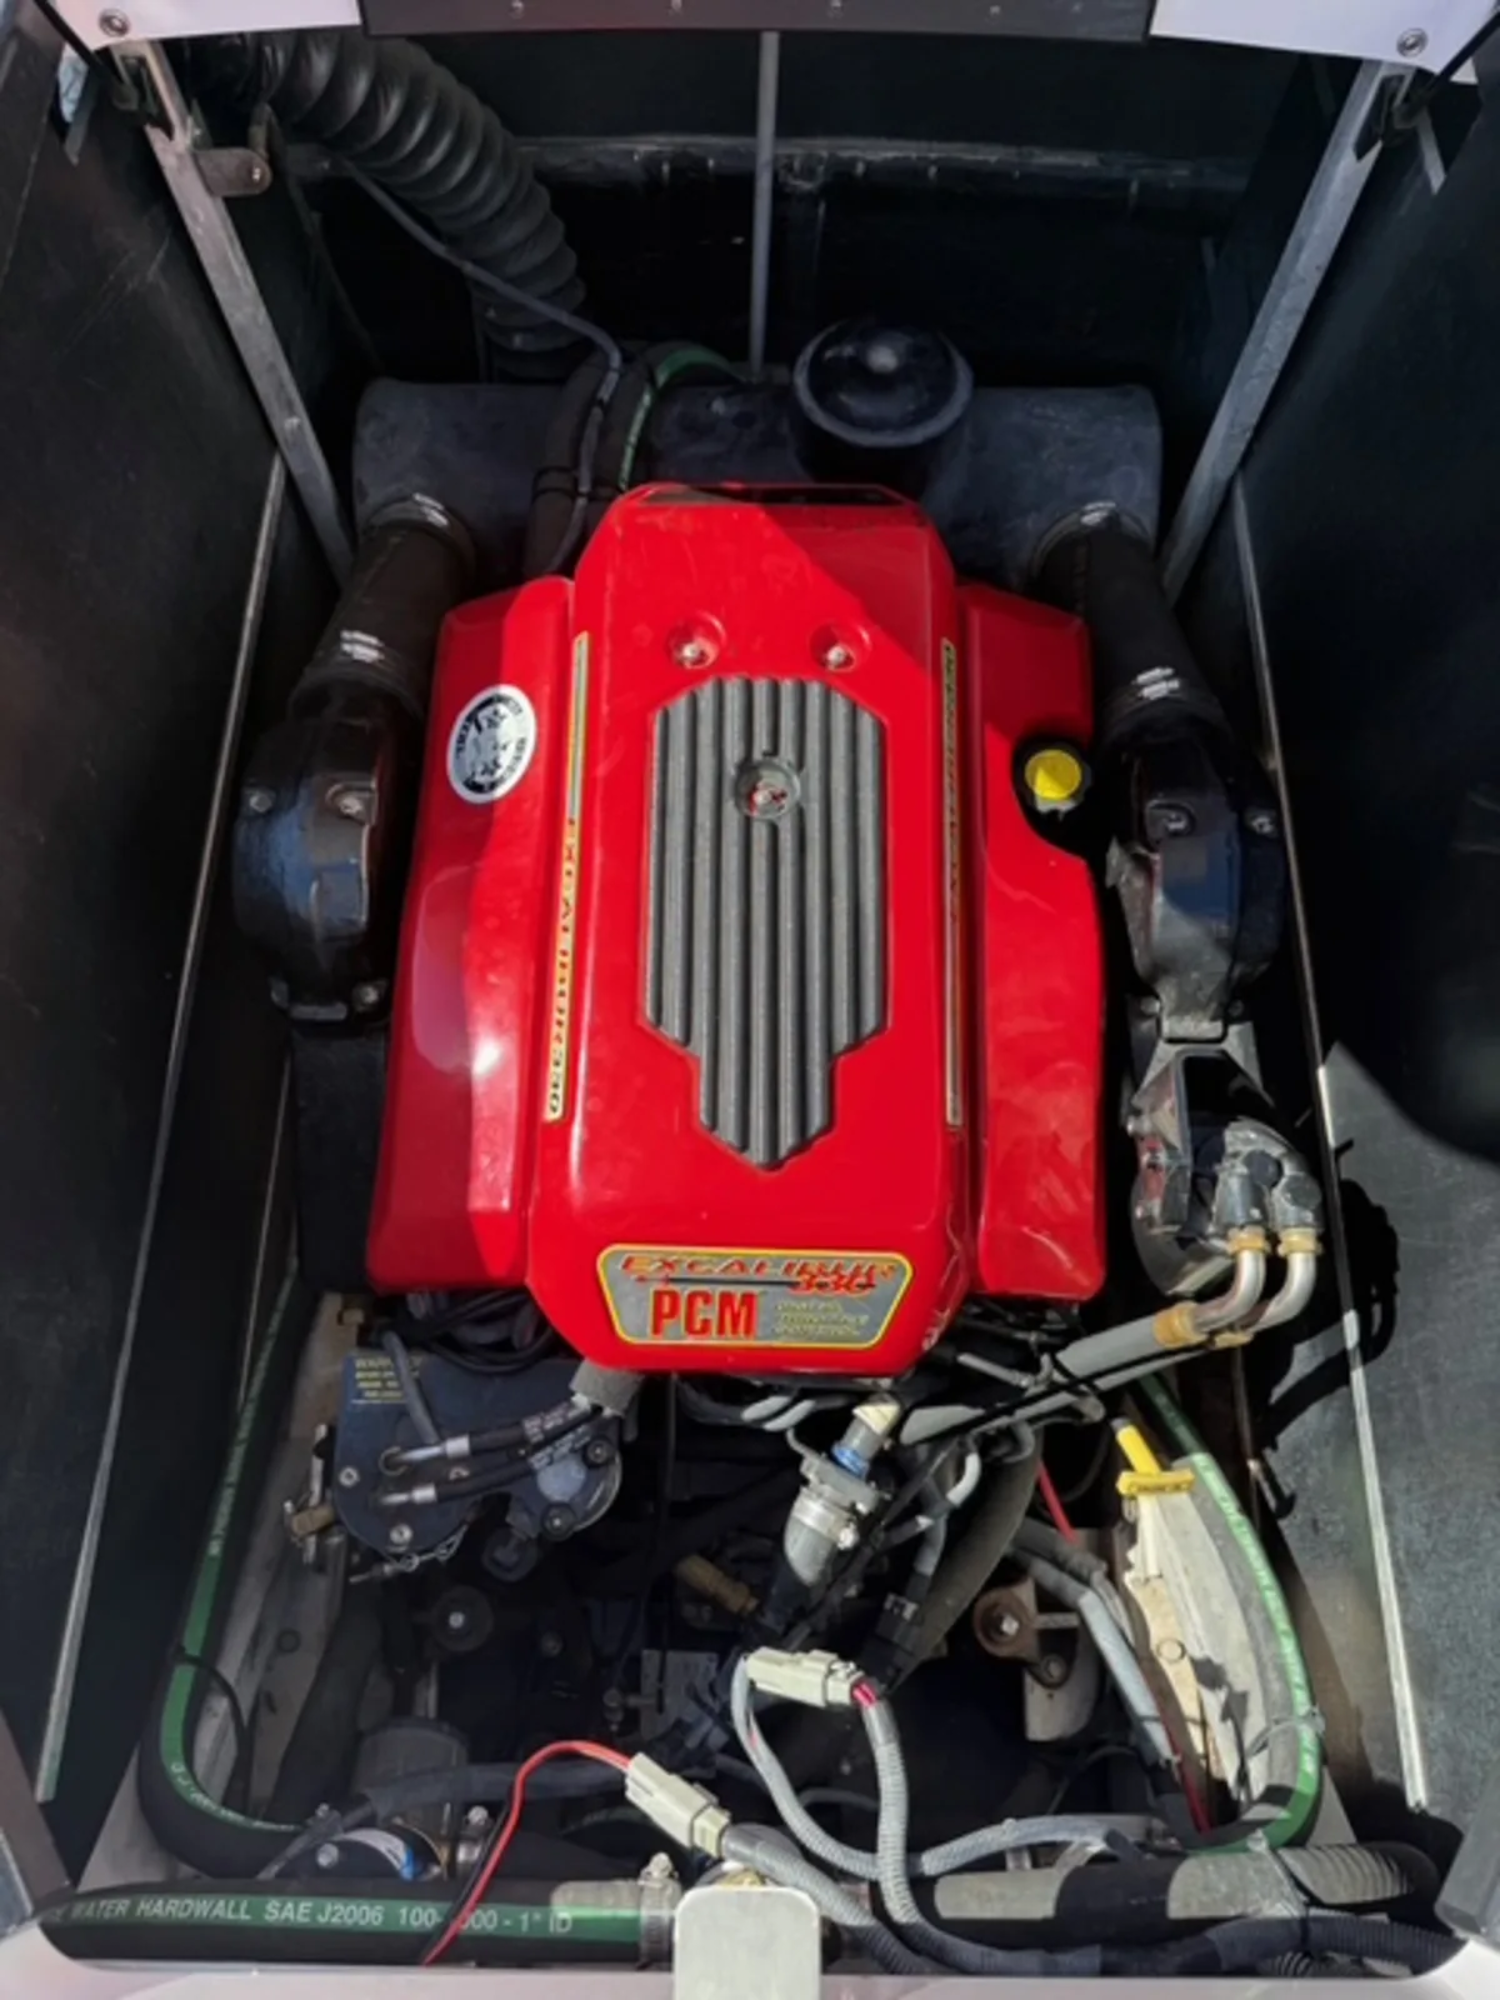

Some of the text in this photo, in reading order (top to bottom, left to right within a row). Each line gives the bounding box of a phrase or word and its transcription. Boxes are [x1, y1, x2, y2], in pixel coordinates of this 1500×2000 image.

[649, 1288, 758, 1338] PCM
[72, 1898, 129, 1919] WATER
[135, 1897, 251, 1920] HARDWALL
[264, 1899, 314, 1922] SAE
[316, 1903, 385, 1926] J2006
[549, 1910, 575, 1933] ID
